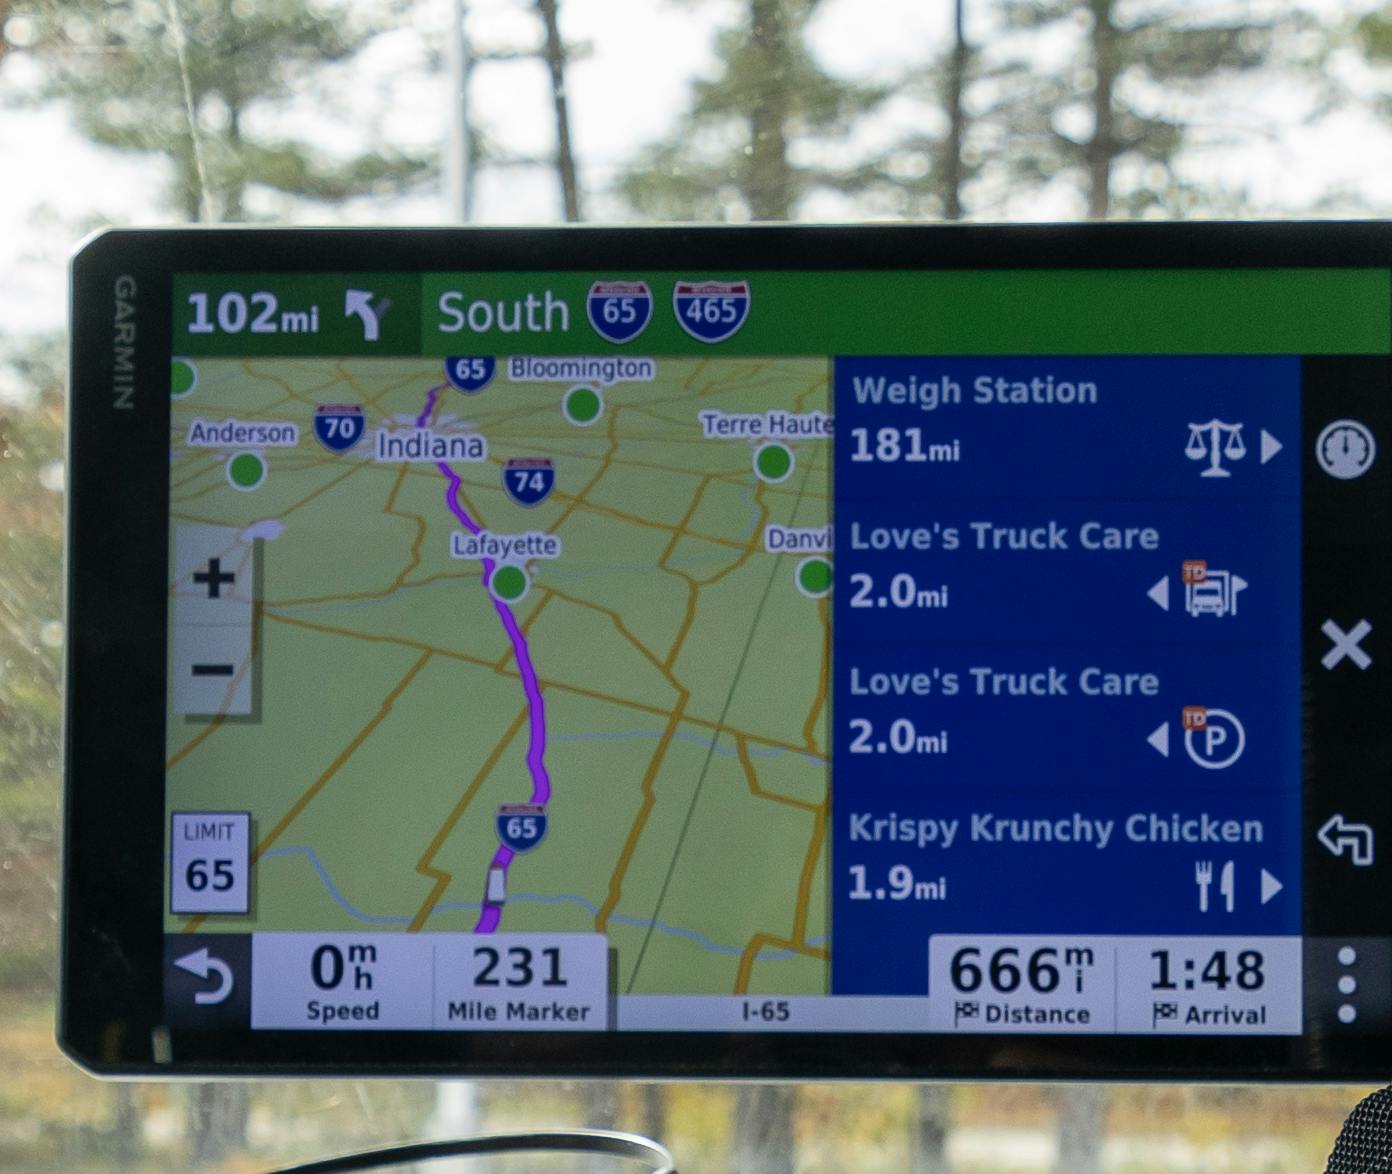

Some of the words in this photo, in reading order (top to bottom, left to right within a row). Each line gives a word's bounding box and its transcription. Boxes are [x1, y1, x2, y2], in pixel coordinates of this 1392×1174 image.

[438, 290, 570, 333] South
[603, 298, 637, 324] 65
[686, 298, 738, 324] 465
[113, 275, 137, 410] GARMIN
[455, 358, 486, 380] 65
[511, 357, 651, 382] Bloomington
[853, 375, 961, 411] Weigh
[974, 375, 1097, 404] Station
[192, 422, 295, 443] Anderson
[324, 417, 355, 438] 70
[703, 413, 762, 435] Terre
[769, 413, 835, 435] Haute
[379, 432, 483, 458] Indiana
[514, 472, 545, 492] 74
[454, 534, 557, 558] Lafayette
[851, 522, 960, 550] Love's
[970, 521, 1068, 550] Truck
[1079, 522, 1160, 550] Care
[850, 668, 959, 696] Love's
[969, 667, 1068, 696] Truck
[1079, 668, 1160, 696] Care
[1206, 726, 1227, 756] P
[184, 823, 235, 842] LIMIT
[507, 818, 538, 839] 65
[849, 813, 958, 849] Krispy
[971, 813, 1114, 850] Krunchy
[1126, 813, 1264, 843] Chicken
[185, 860, 234, 891] 65
[473, 946, 568, 988] 231
[1151, 950, 1265, 992] 1:48
[307, 1001, 379, 1025] Speed
[448, 1001, 497, 1021] Mile
[507, 1001, 590, 1021] Marker
[743, 1002, 790, 1021] I-65
[985, 1004, 1091, 1026] Distance
[1185, 1005, 1267, 1026] Arrival
